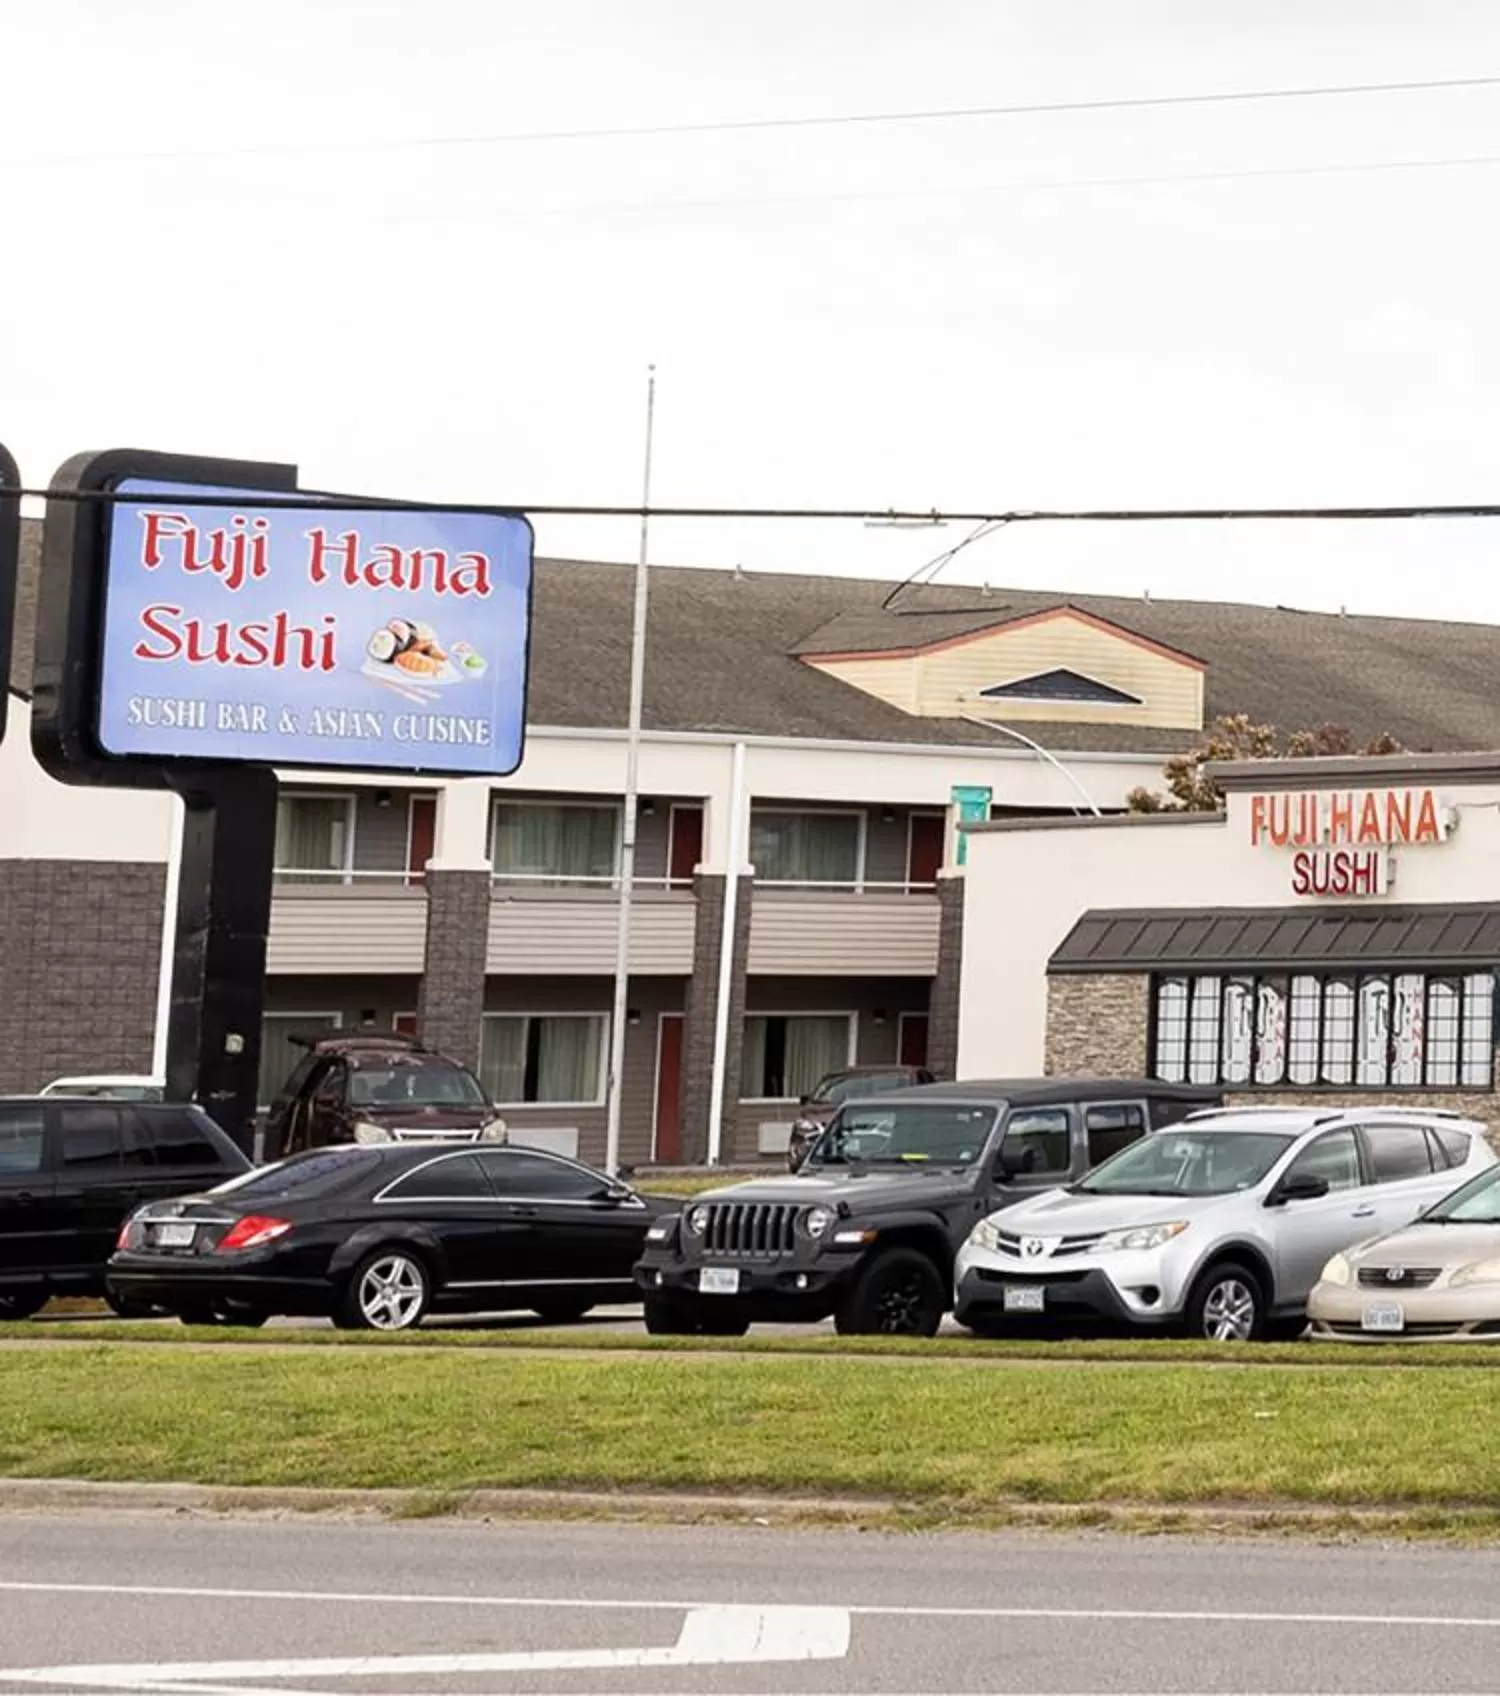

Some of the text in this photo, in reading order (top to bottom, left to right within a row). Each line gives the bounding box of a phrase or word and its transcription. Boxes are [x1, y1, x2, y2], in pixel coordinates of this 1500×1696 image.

[141, 511, 492, 597] Fuji Hana
[134, 605, 336, 671] Sushi
[127, 696, 492, 747] SUSHI BAR & ASIAN CUISINE
[1251, 789, 1441, 847] FUJI HANA
[1292, 851, 1379, 895] SUSHI
